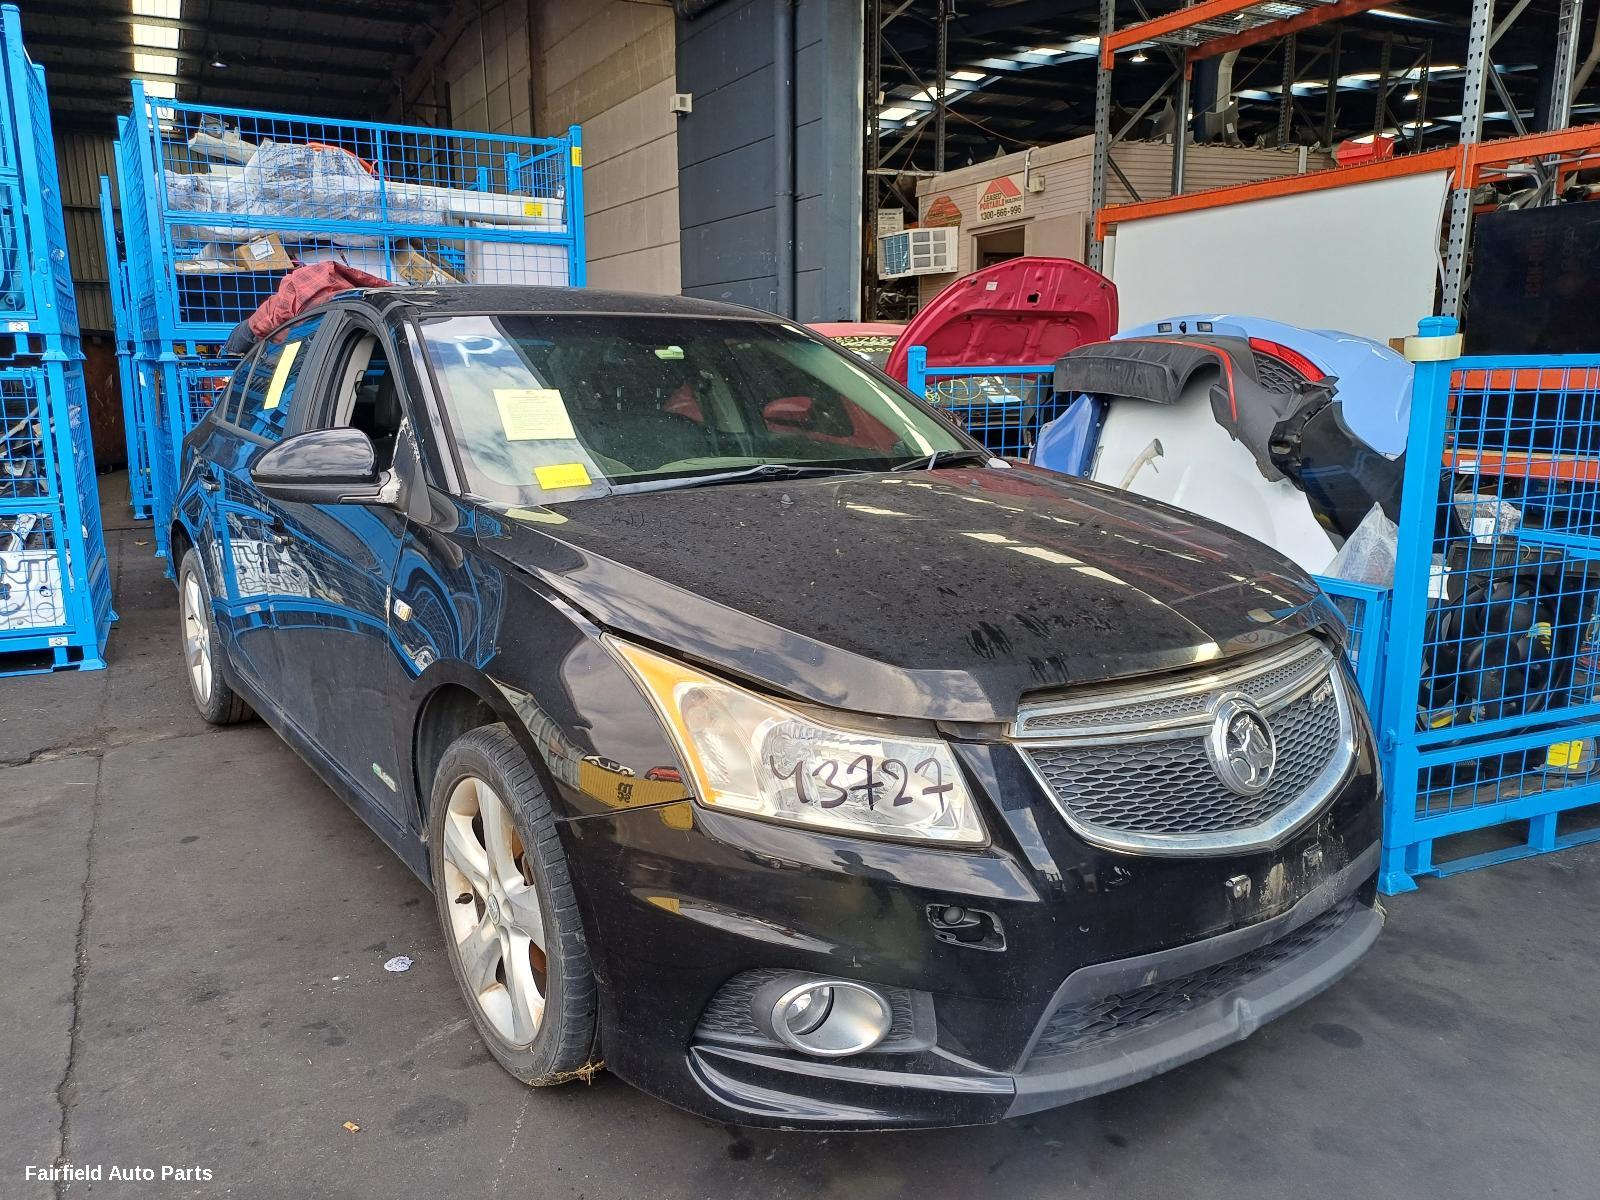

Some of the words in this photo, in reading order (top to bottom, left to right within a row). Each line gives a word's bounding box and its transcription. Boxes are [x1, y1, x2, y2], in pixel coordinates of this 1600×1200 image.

[983, 192, 1002, 203] LEASED
[980, 199, 1005, 211] PORTABLE
[769, 754, 954, 812] 43727
